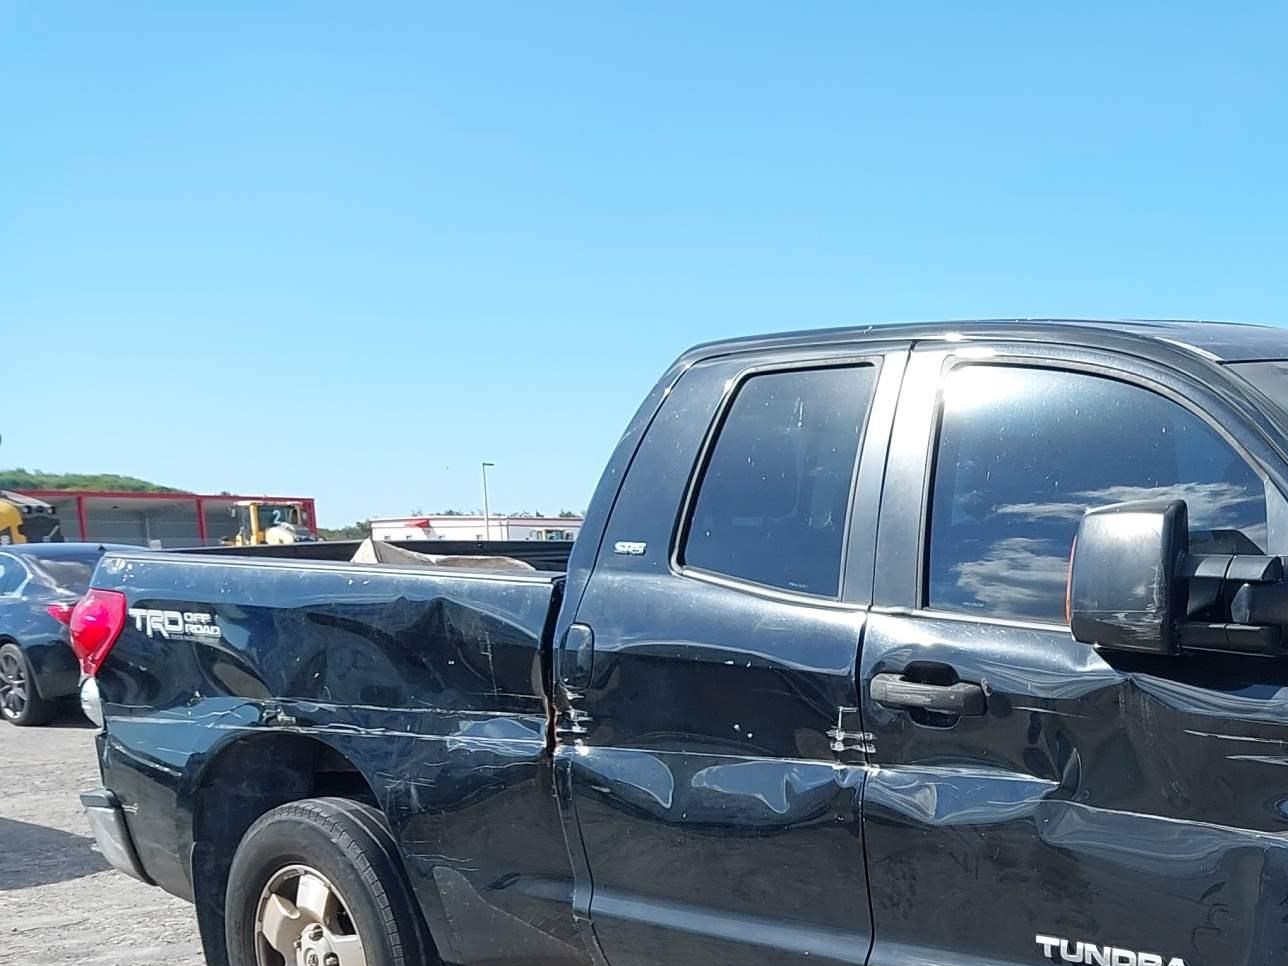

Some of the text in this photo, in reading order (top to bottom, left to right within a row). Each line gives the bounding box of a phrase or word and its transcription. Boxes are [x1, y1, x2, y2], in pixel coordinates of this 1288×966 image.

[128, 607, 184, 639] TRD
[183, 611, 212, 624] OFF
[184, 623, 221, 638] ROAD
